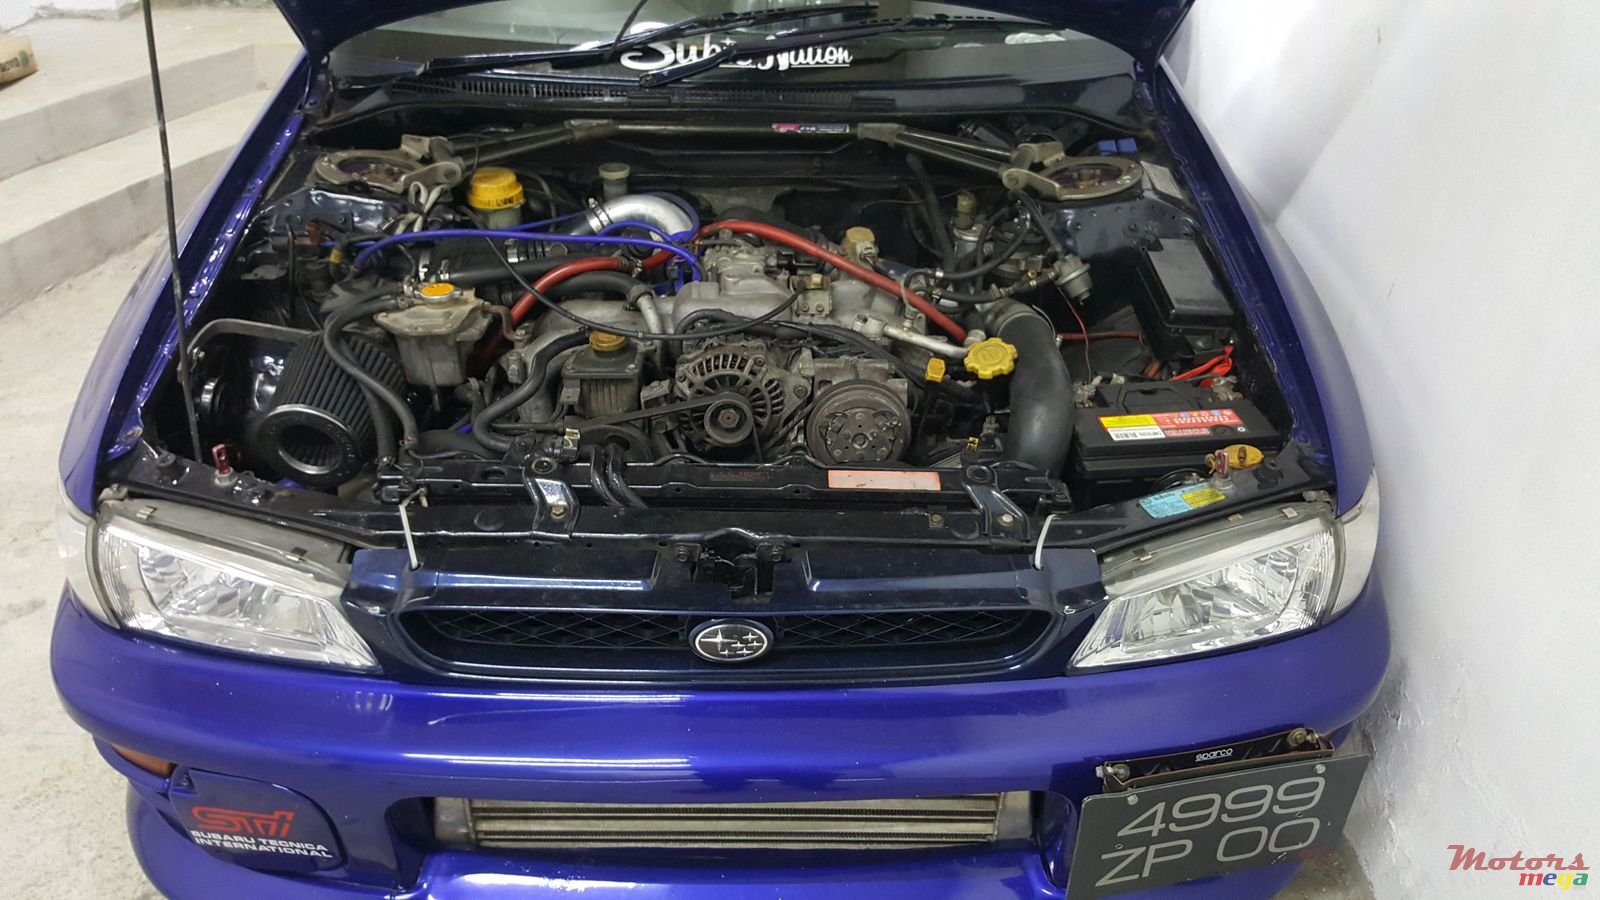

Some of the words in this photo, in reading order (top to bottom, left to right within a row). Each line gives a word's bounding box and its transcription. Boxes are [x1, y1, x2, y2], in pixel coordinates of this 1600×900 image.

[620, 21, 757, 70] Sub
[1195, 748, 1233, 762] sparco
[1117, 777, 1326, 838] 4999
[190, 830, 255, 843] SUBARU
[257, 838, 329, 851] TECNICA
[194, 837, 333, 858] INTERNATIONAL
[1095, 839, 1193, 887] ZP
